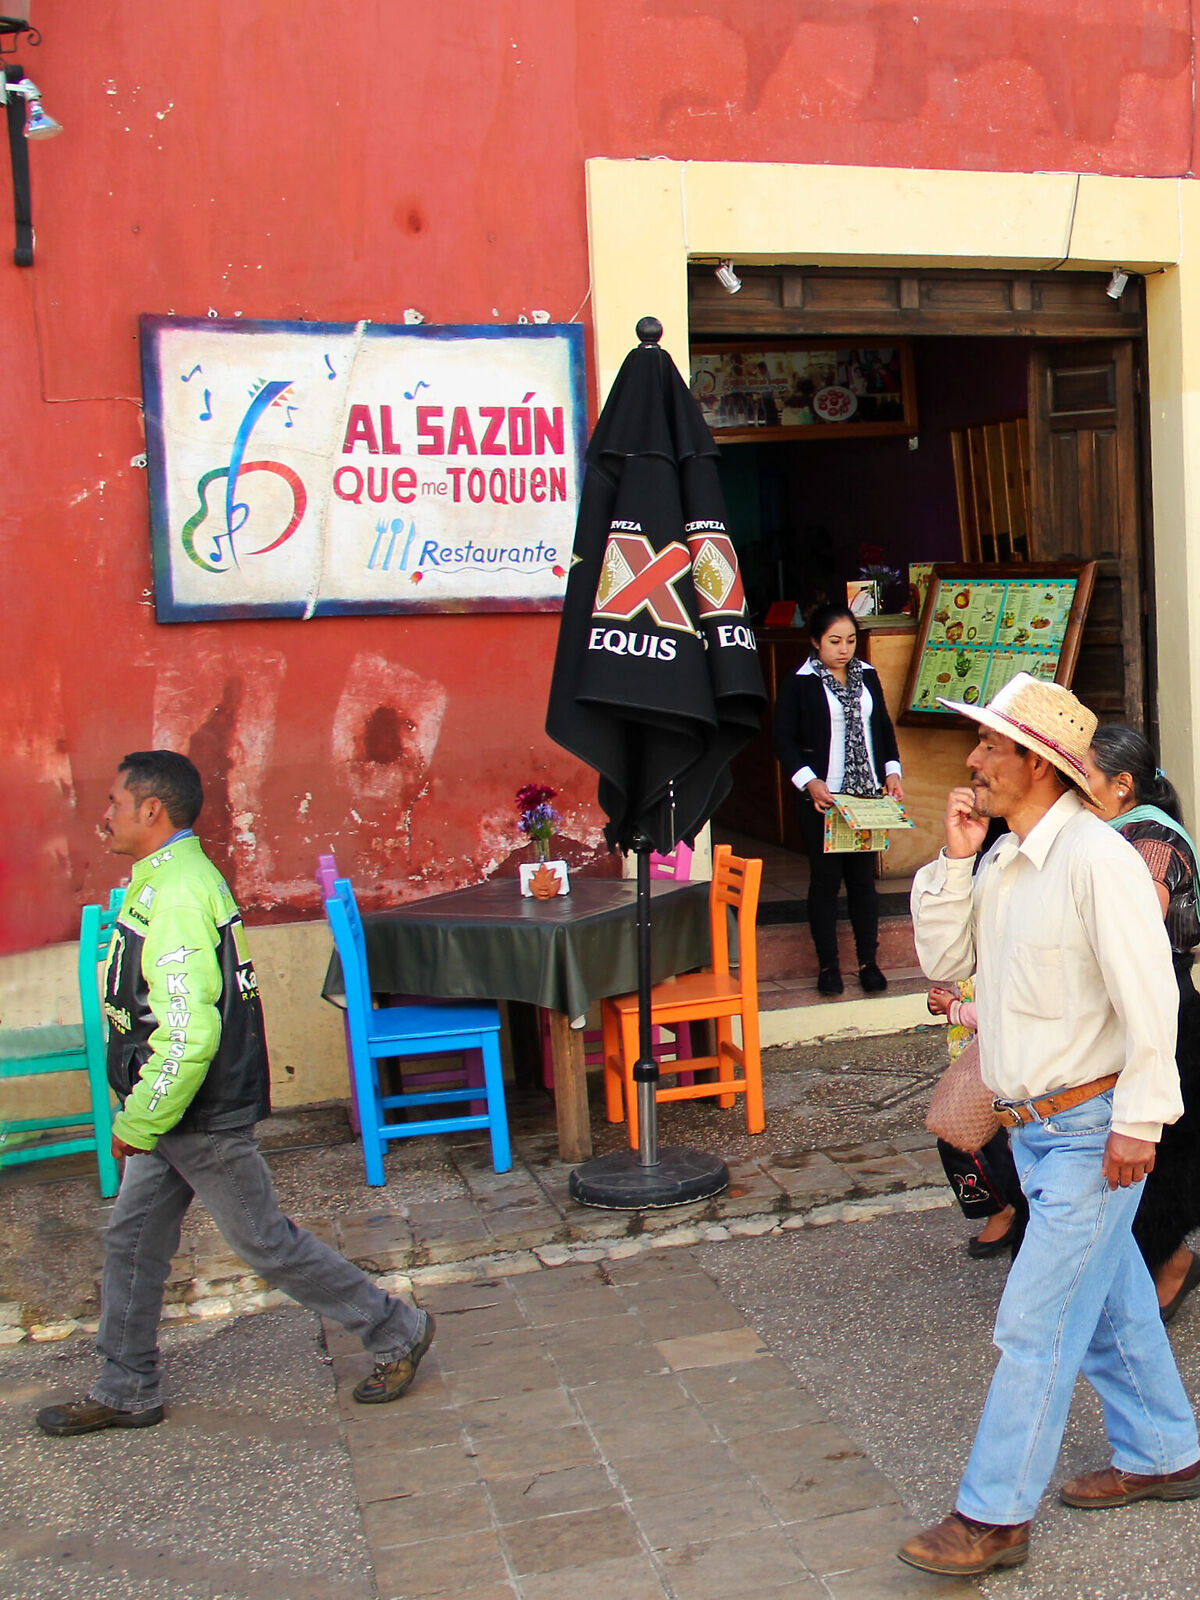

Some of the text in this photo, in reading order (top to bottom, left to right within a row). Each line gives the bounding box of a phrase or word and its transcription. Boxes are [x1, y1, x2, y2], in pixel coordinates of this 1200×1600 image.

[342, 392, 566, 456] AL SAZÓN
[421, 479, 448, 496] me
[610, 520, 642, 532] RVEZA
[685, 520, 726, 531] CERVEZA
[419, 538, 558, 567] Restaurante
[588, 627, 677, 662] EQUIS
[716, 625, 757, 651] EQU
[147, 972, 190, 1113] Kawasaki
